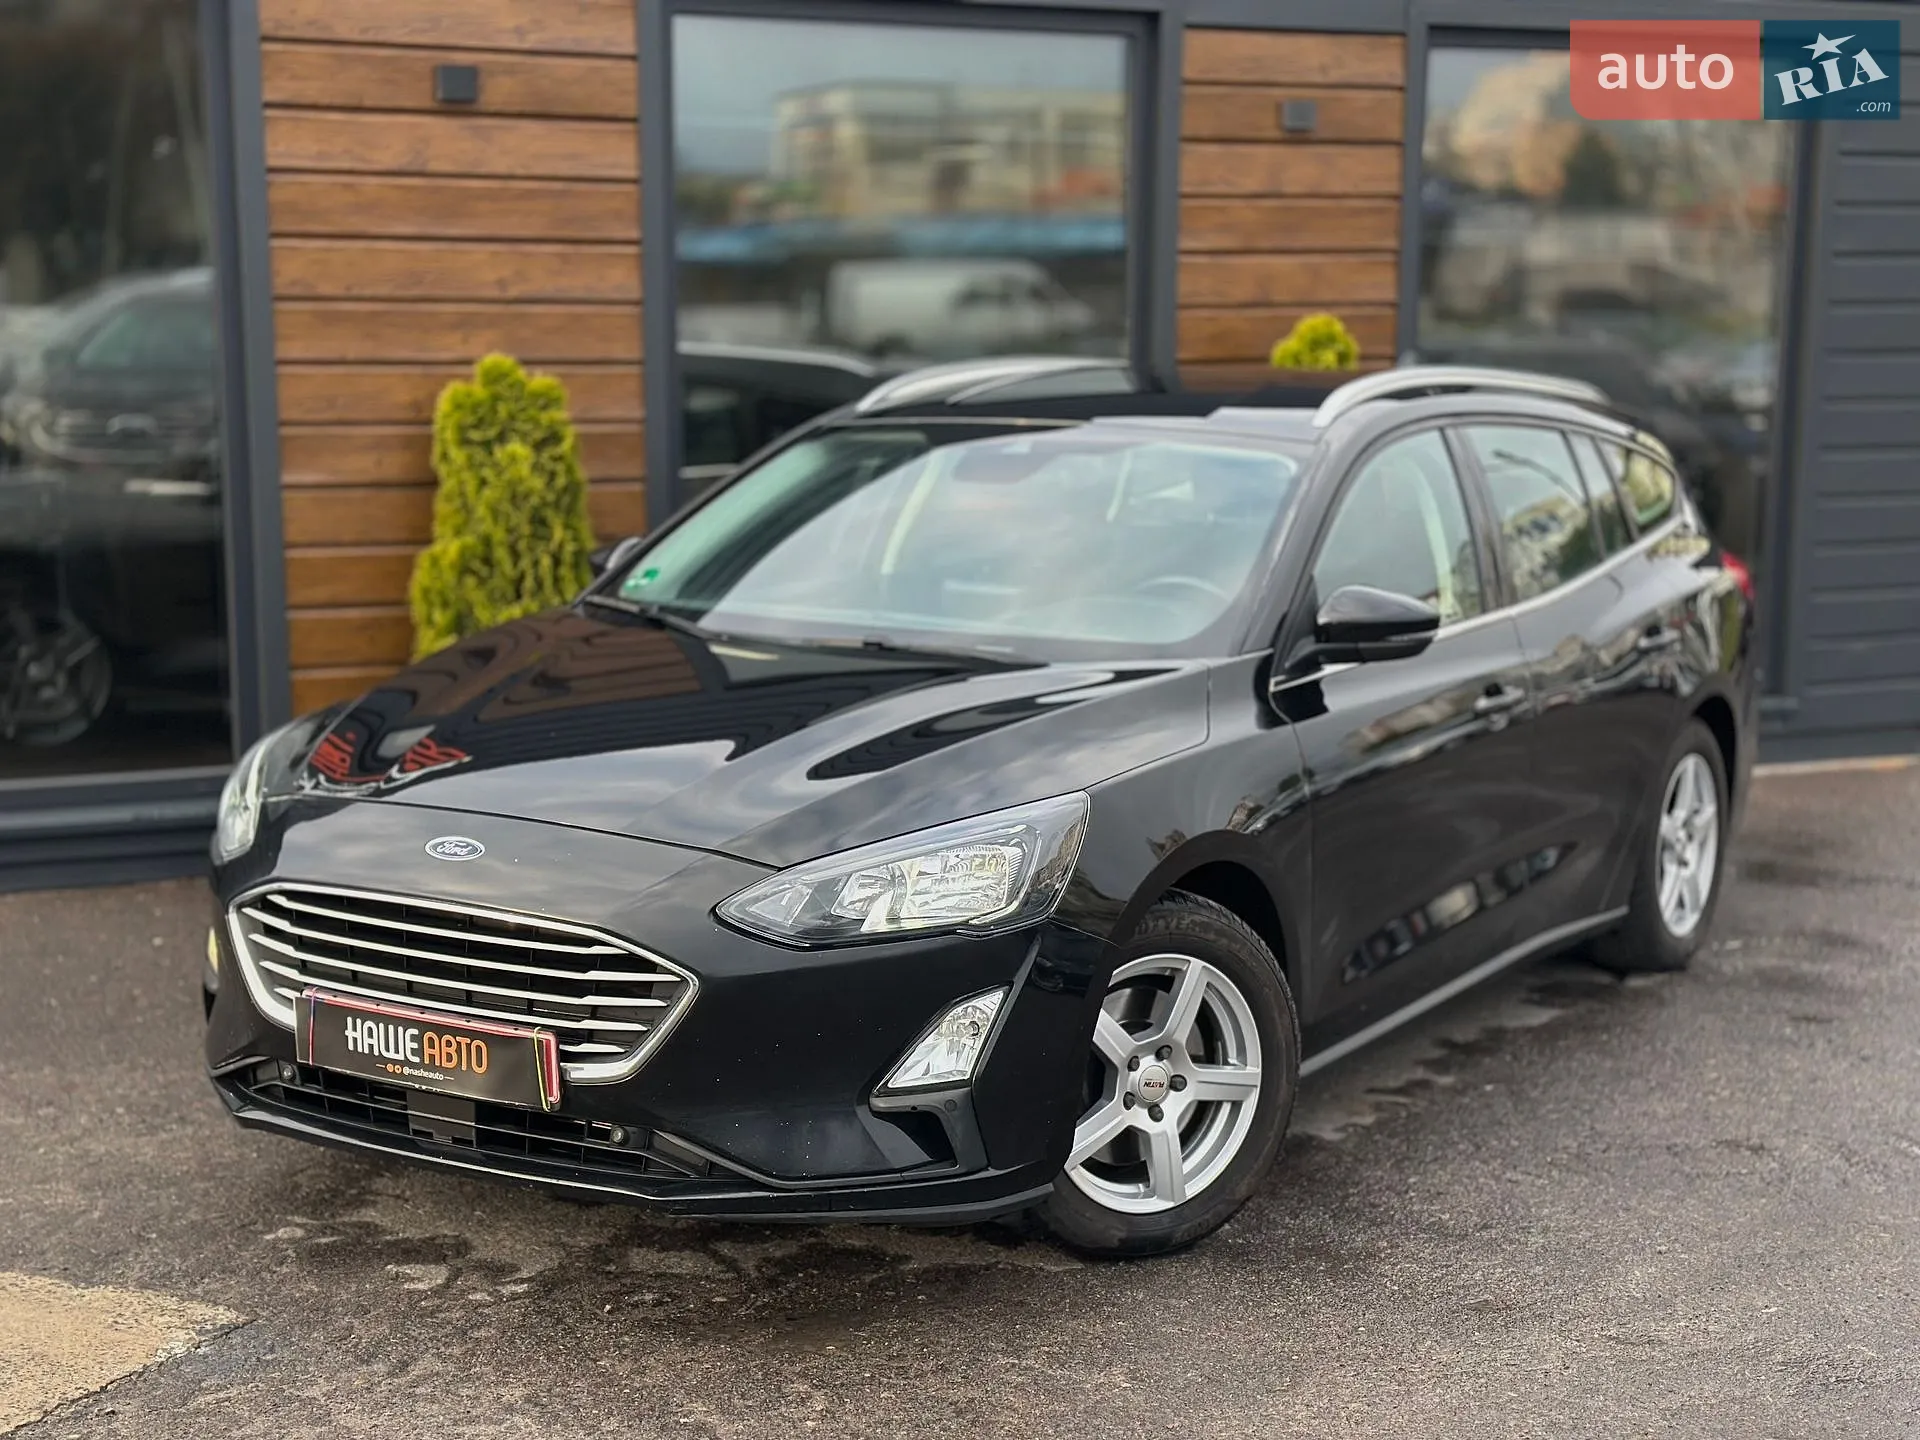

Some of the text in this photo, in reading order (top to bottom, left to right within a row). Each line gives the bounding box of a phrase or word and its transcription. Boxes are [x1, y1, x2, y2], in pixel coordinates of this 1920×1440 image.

[436, 841, 472, 856] Ford
[345, 1016, 488, 1074] НАШЕ АВТО
[402, 1066, 444, 1081] @nasheauto
